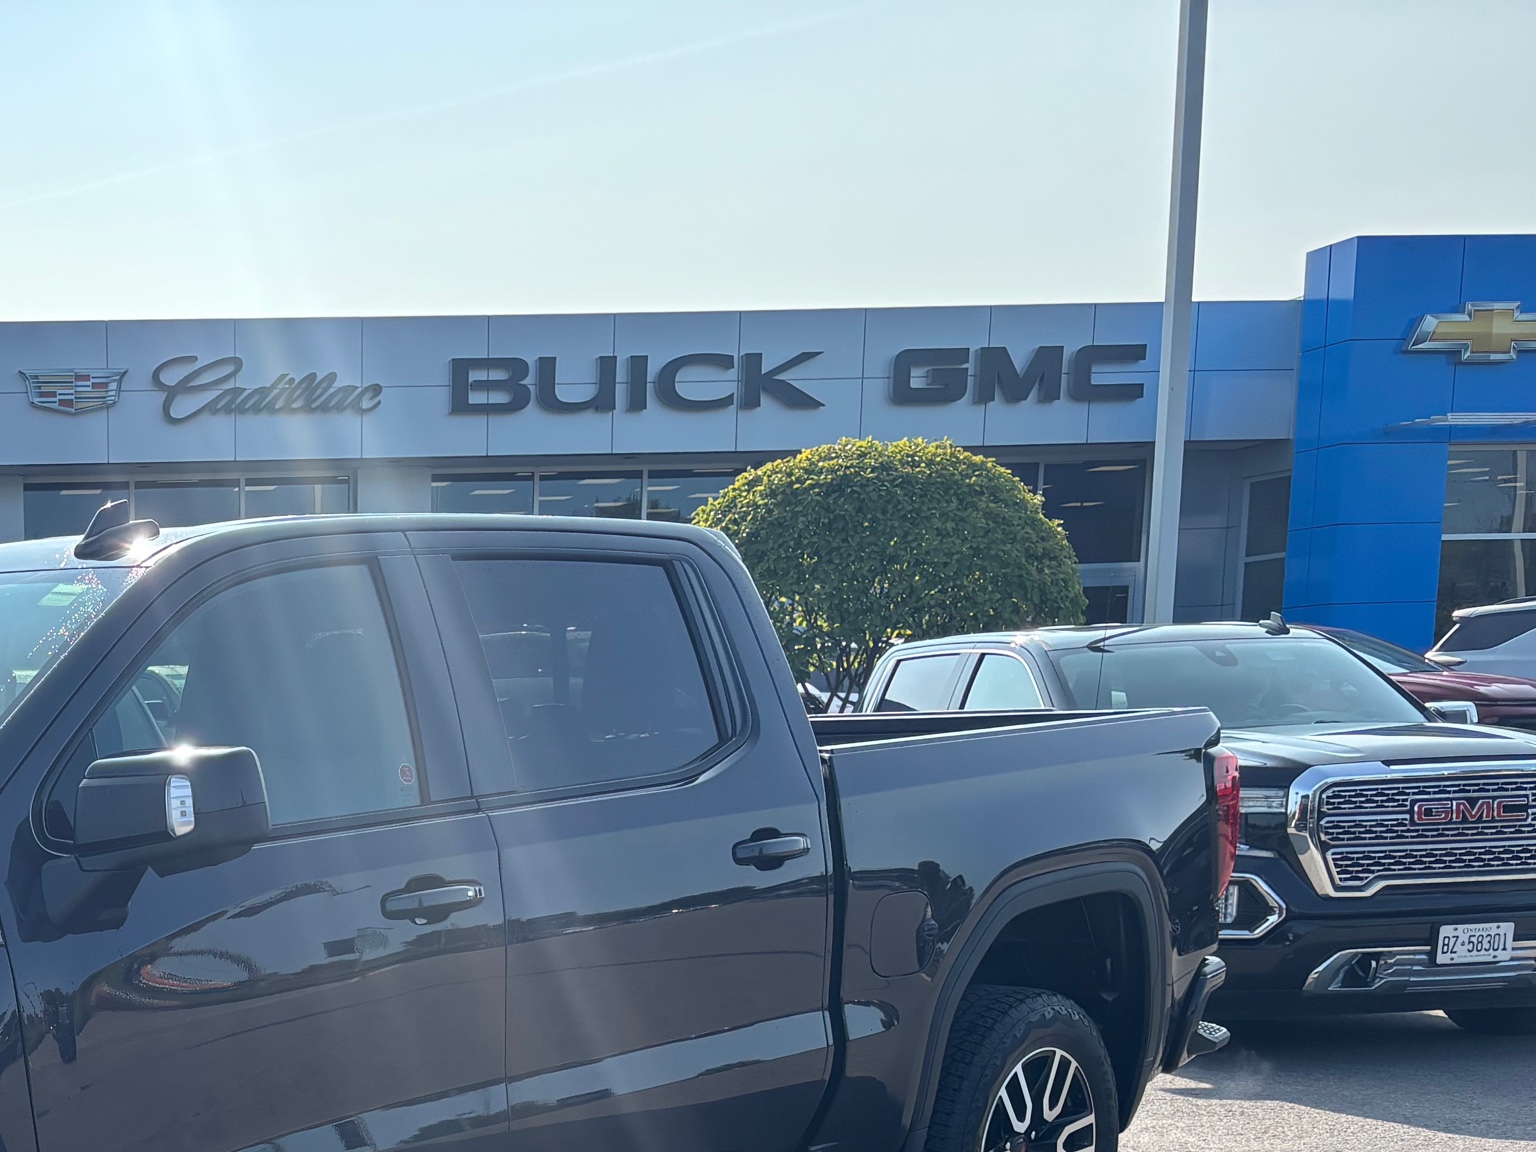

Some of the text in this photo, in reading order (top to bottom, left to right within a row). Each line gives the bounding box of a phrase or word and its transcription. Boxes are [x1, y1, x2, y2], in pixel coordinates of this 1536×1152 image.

[151, 354, 382, 425] Cadillac
[449, 351, 825, 415] BUICK
[889, 343, 1148, 405] GMC
[1414, 798, 1528, 823] GMC
